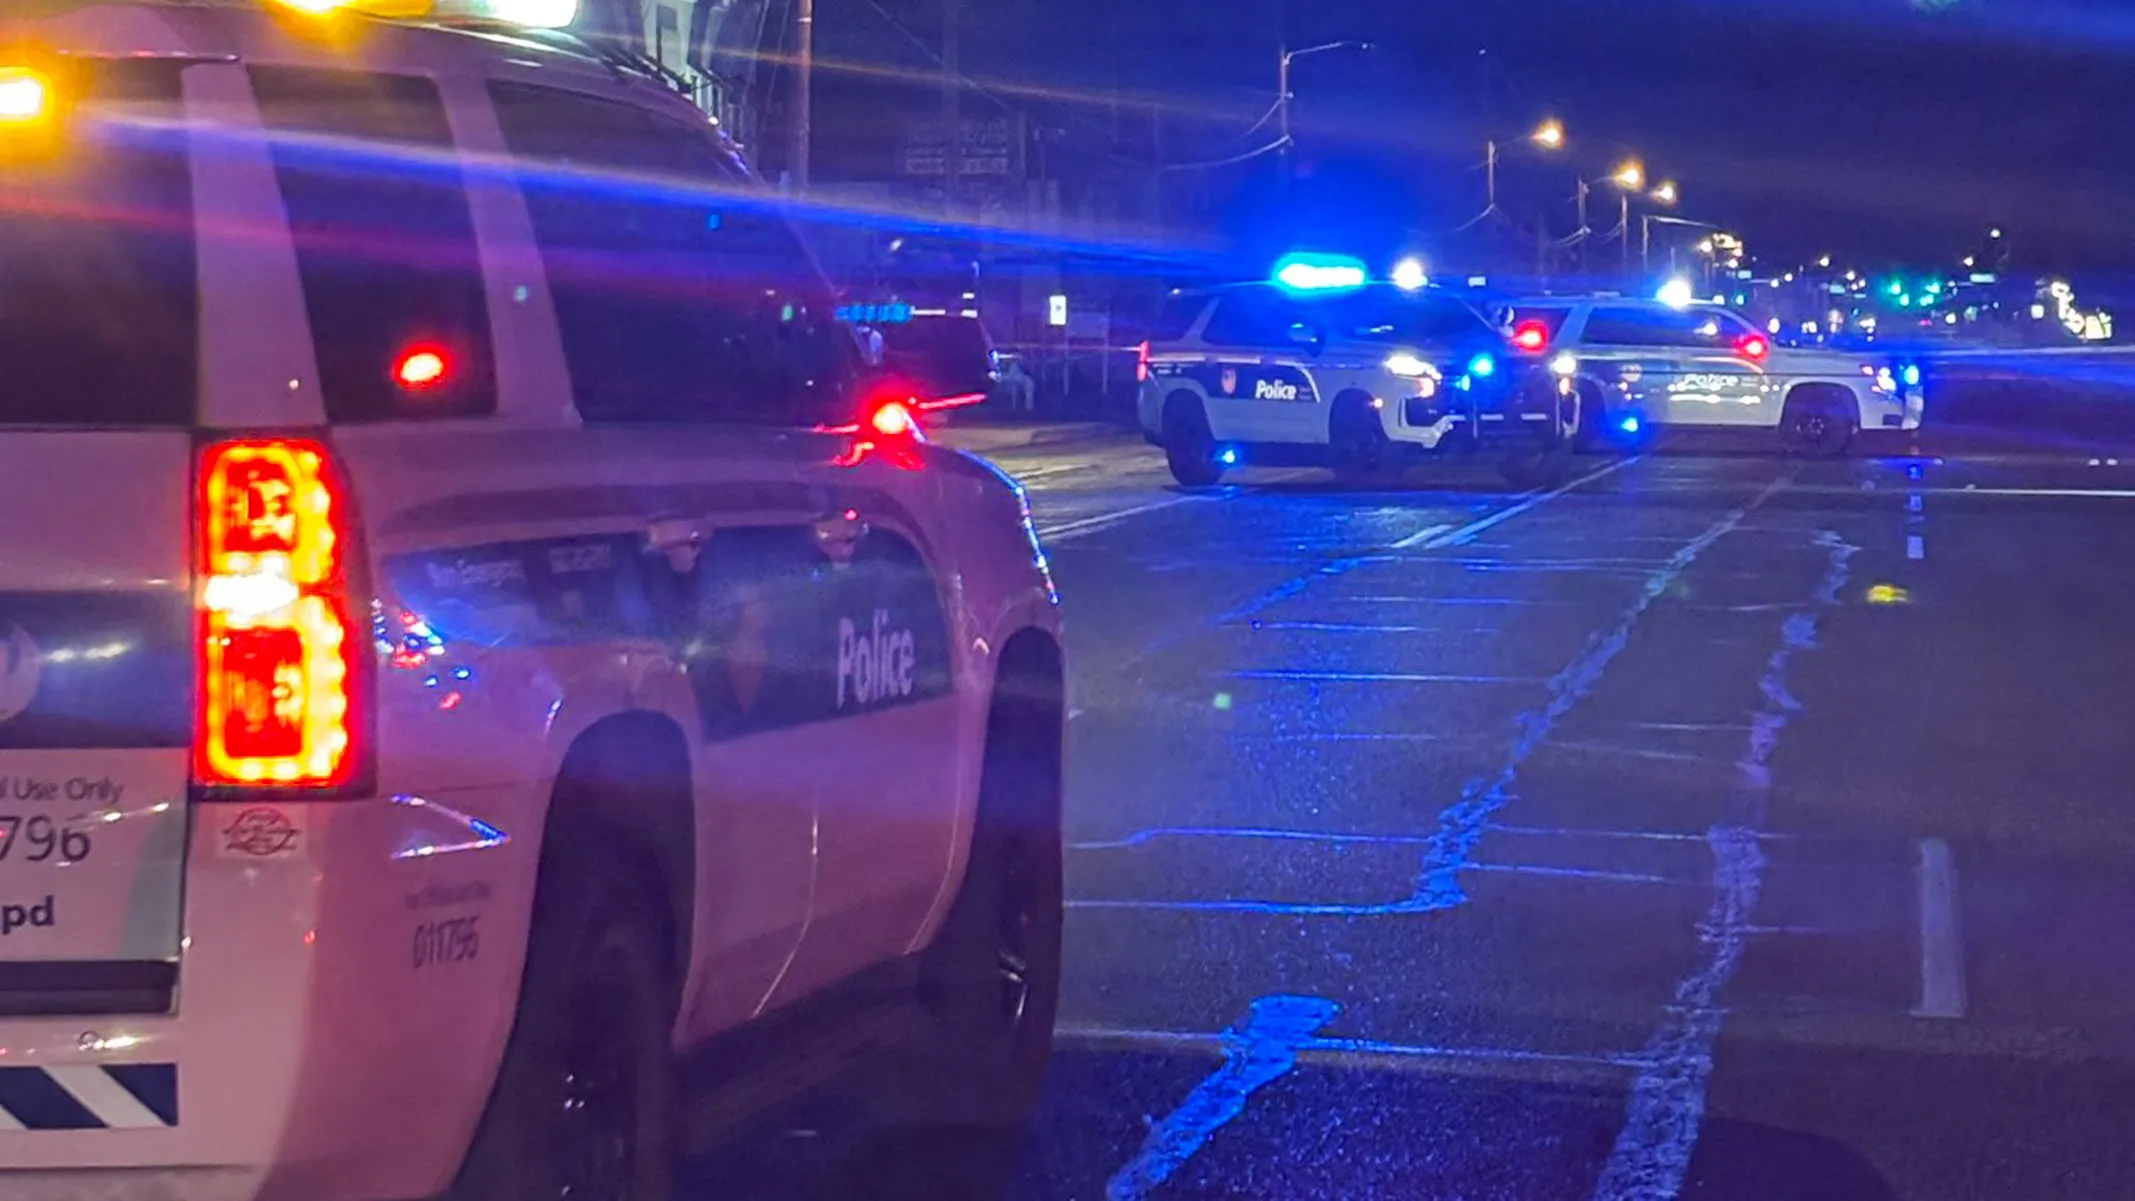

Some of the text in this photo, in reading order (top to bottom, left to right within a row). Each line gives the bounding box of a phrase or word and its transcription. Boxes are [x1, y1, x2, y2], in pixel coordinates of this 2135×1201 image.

[1255, 379, 1297, 400] Police
[836, 607, 916, 709] Police
[14, 778, 60, 800] Use
[65, 776, 125, 804] Only
[0, 814, 91, 862] 796
[1, 894, 56, 935] pd
